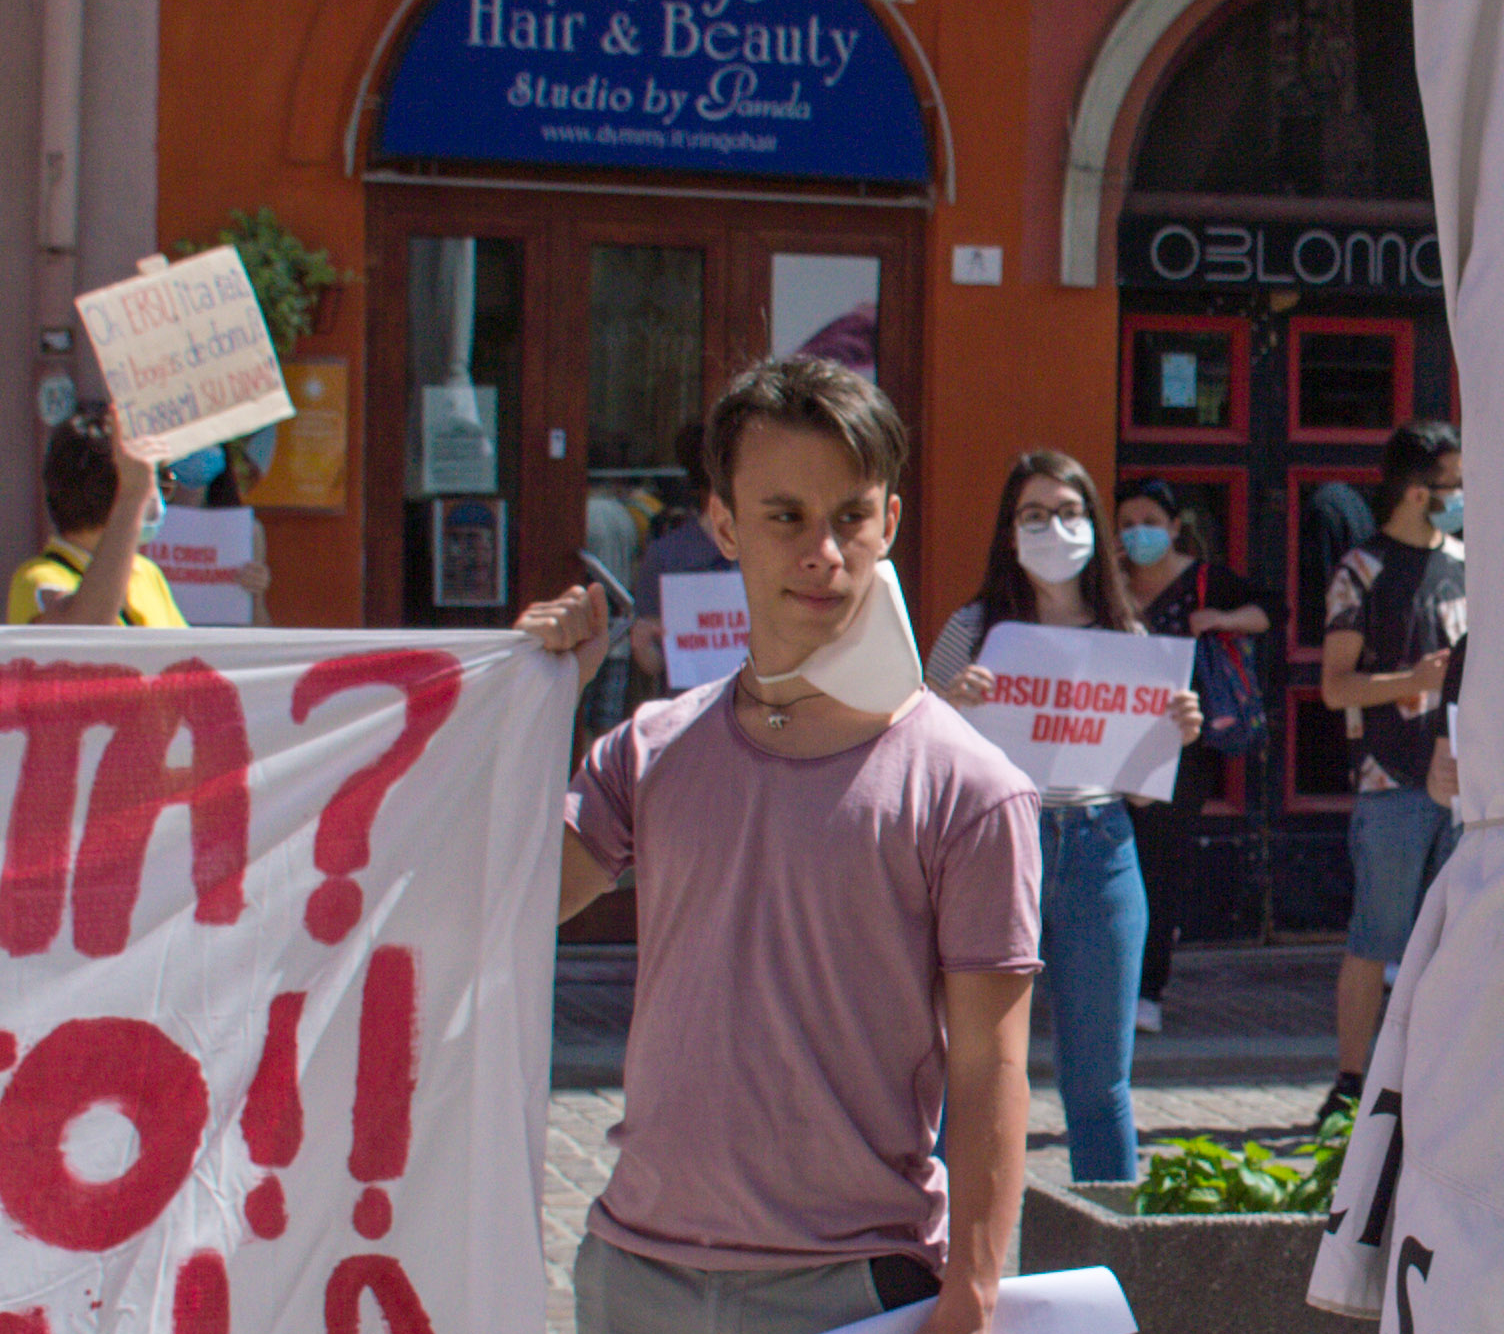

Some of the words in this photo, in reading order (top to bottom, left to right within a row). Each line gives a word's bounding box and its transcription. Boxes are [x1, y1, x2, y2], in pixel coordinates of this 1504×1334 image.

[600, 10, 643, 55] &
[660, 0, 860, 87] Beauty
[507, 70, 634, 113] Studio
[642, 75, 689, 125] by
[1053, 679, 1133, 714] BOGA
[1132, 684, 1171, 716] SU
[1030, 713, 1107, 746] DINAI
